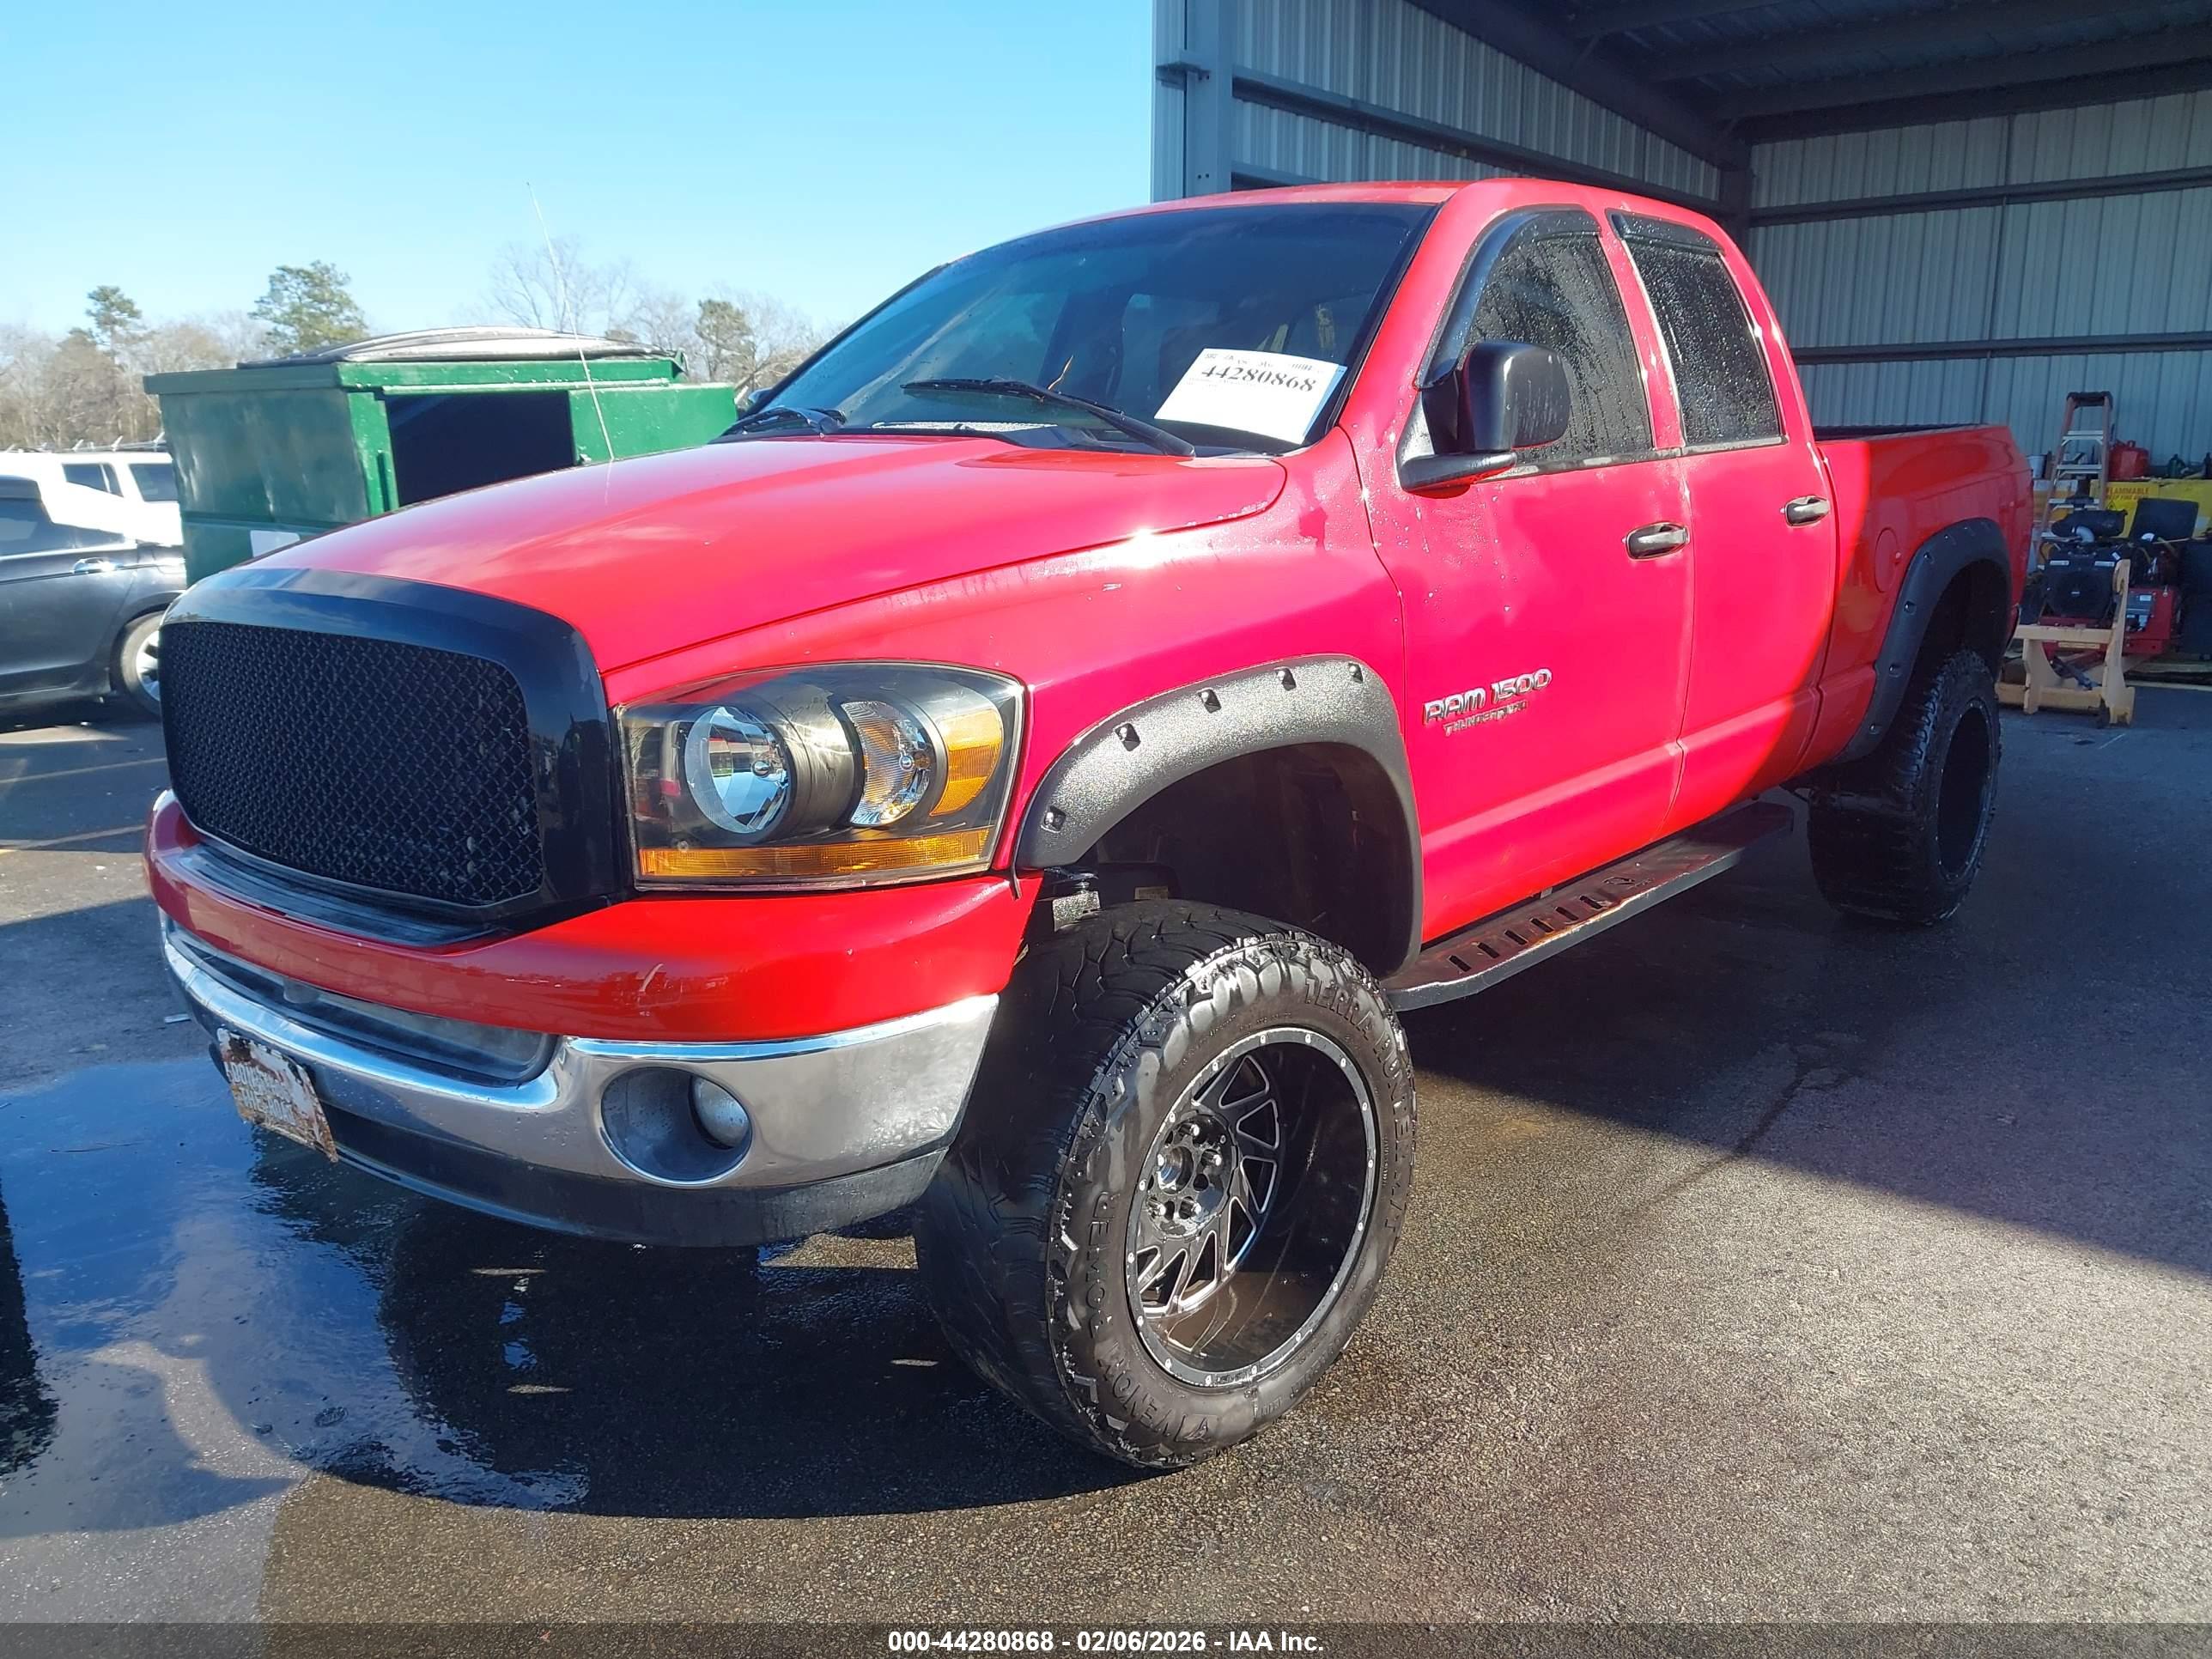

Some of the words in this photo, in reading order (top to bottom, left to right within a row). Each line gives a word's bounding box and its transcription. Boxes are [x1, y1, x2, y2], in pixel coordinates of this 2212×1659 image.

[1201, 365, 1316, 392] 44280868
[1423, 688, 1486, 725] RAM
[1491, 667, 1553, 703] 1500
[1300, 977, 1381, 1042] TERRA
[1097, 1340, 1188, 1443] VENOM
